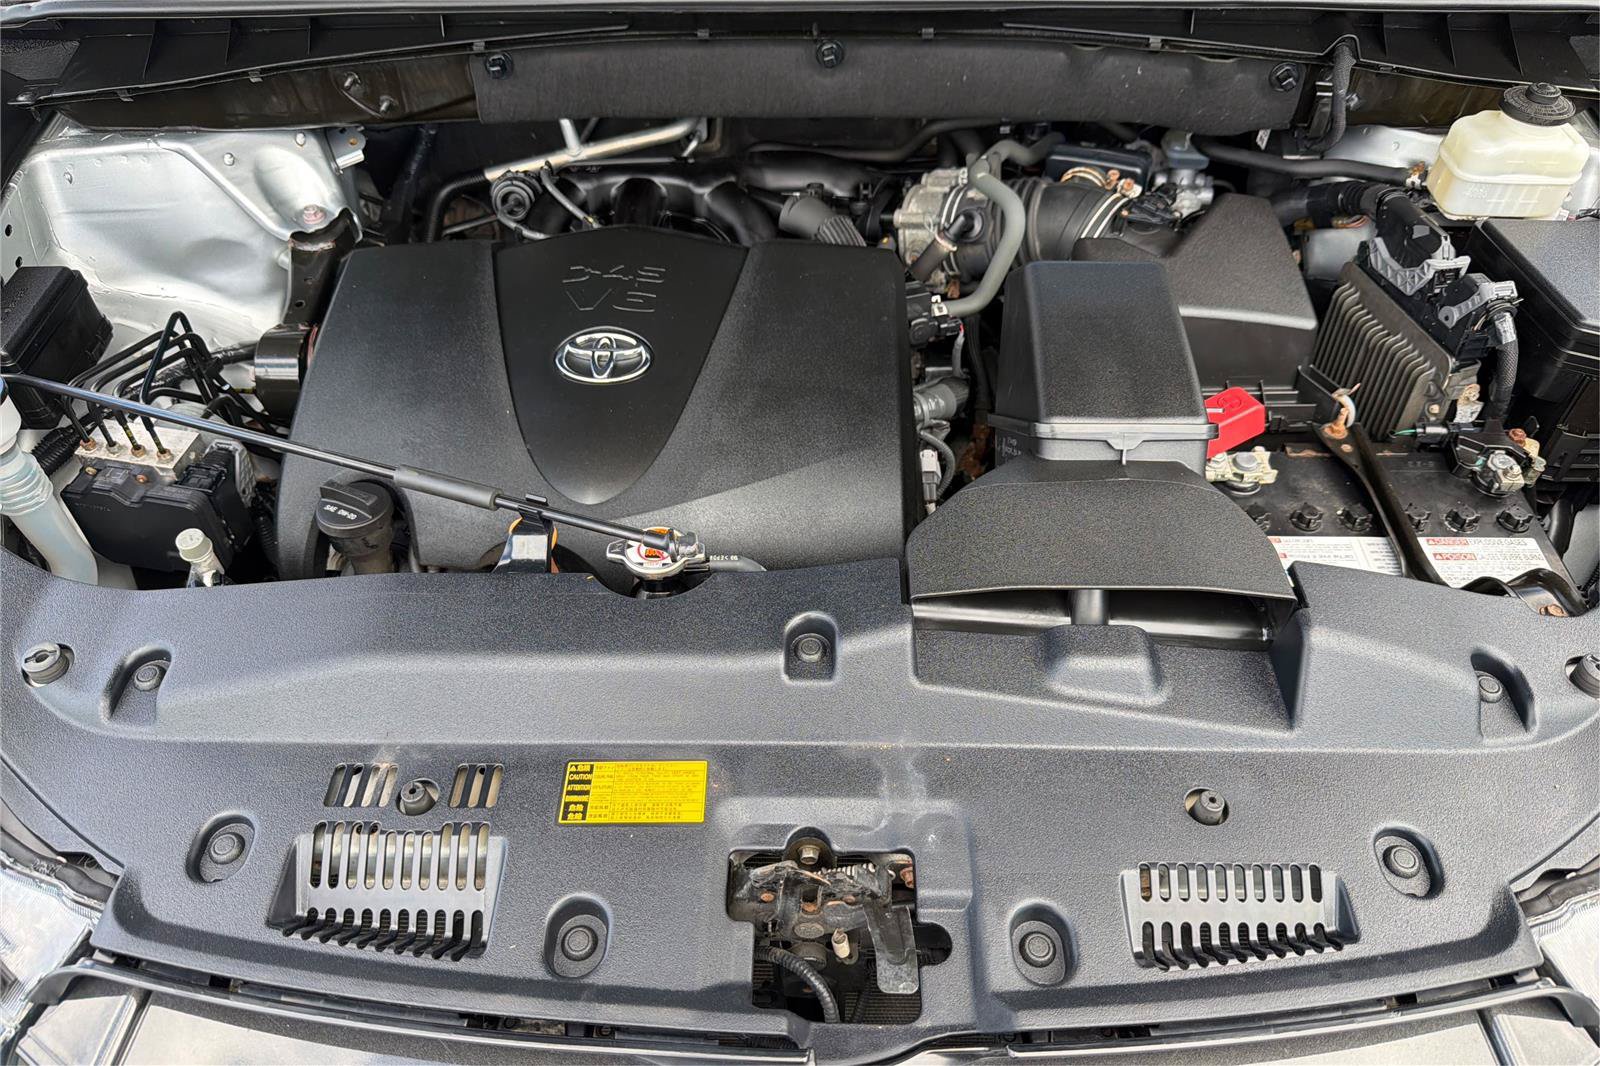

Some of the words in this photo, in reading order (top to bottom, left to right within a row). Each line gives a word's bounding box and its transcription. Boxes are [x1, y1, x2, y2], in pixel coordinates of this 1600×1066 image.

[323, 504, 338, 512] SAE
[568, 773, 593, 781] CAUTION
[566, 784, 592, 792] ATTENTION
